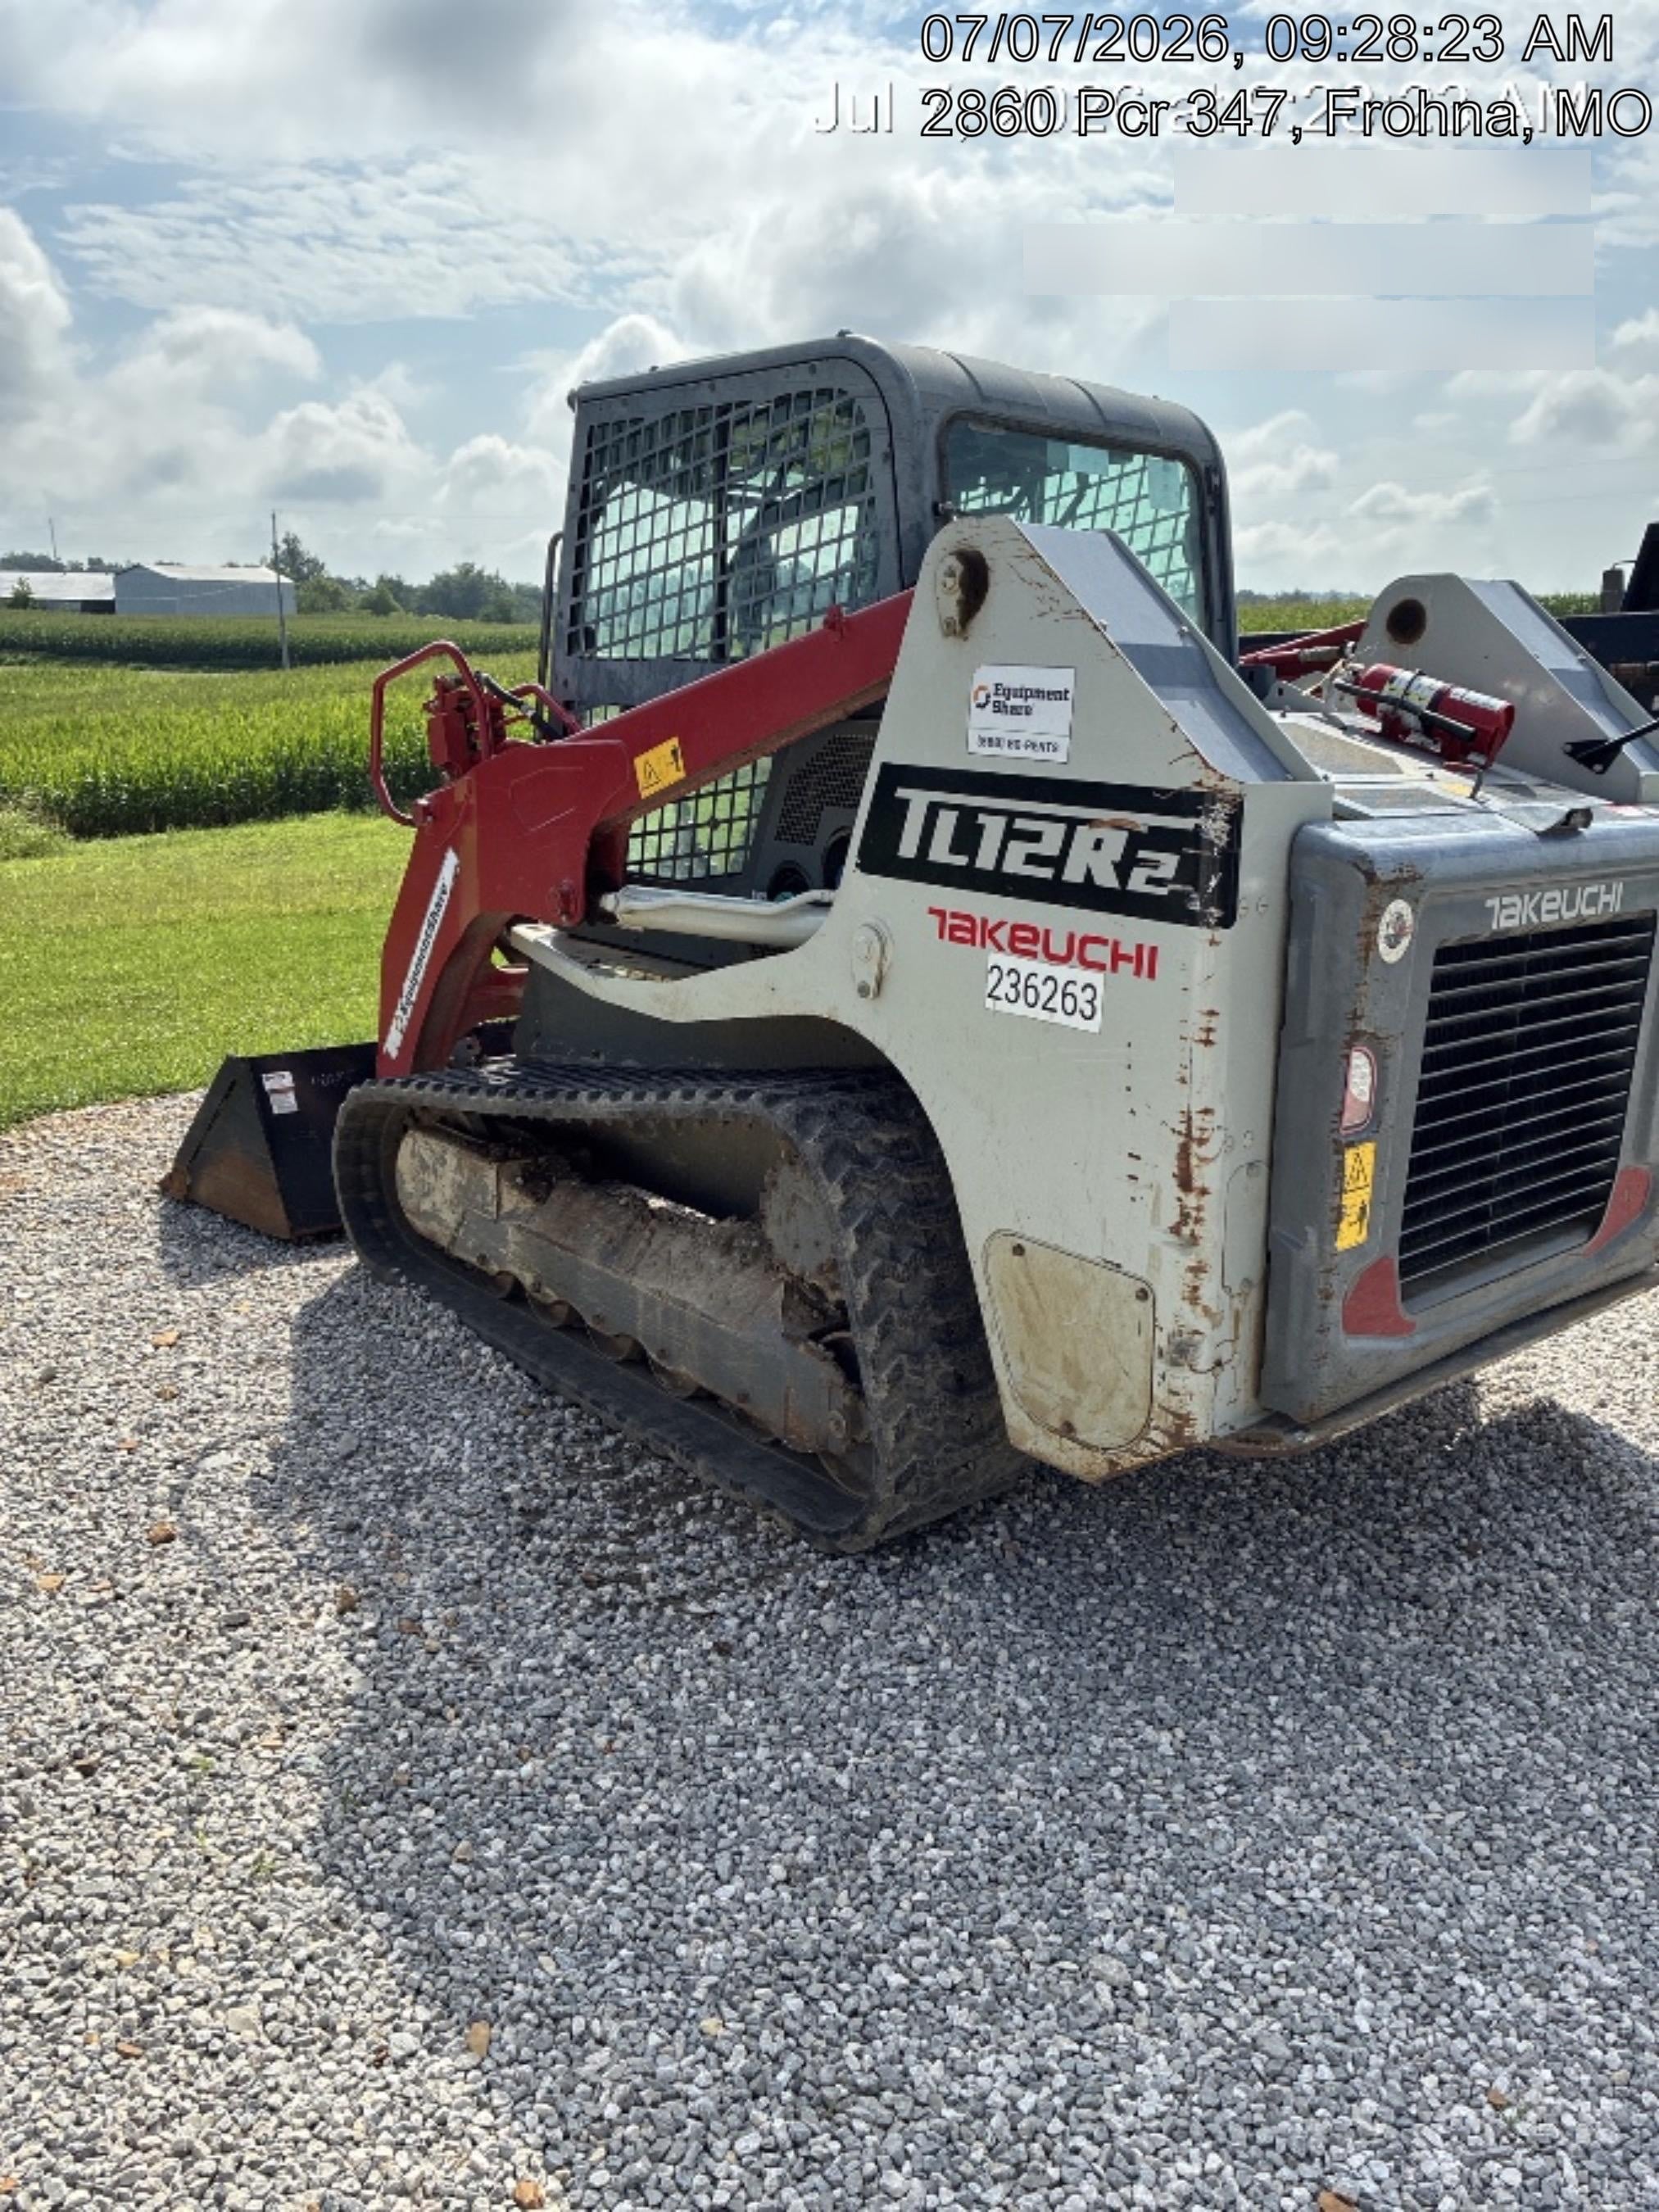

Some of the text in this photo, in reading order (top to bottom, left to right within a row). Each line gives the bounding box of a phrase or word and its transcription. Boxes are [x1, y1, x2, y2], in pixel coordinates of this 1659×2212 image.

[992, 682, 1070, 703] Equipment
[992, 700, 1033, 716] Share
[986, 964, 1098, 1022] 236263
